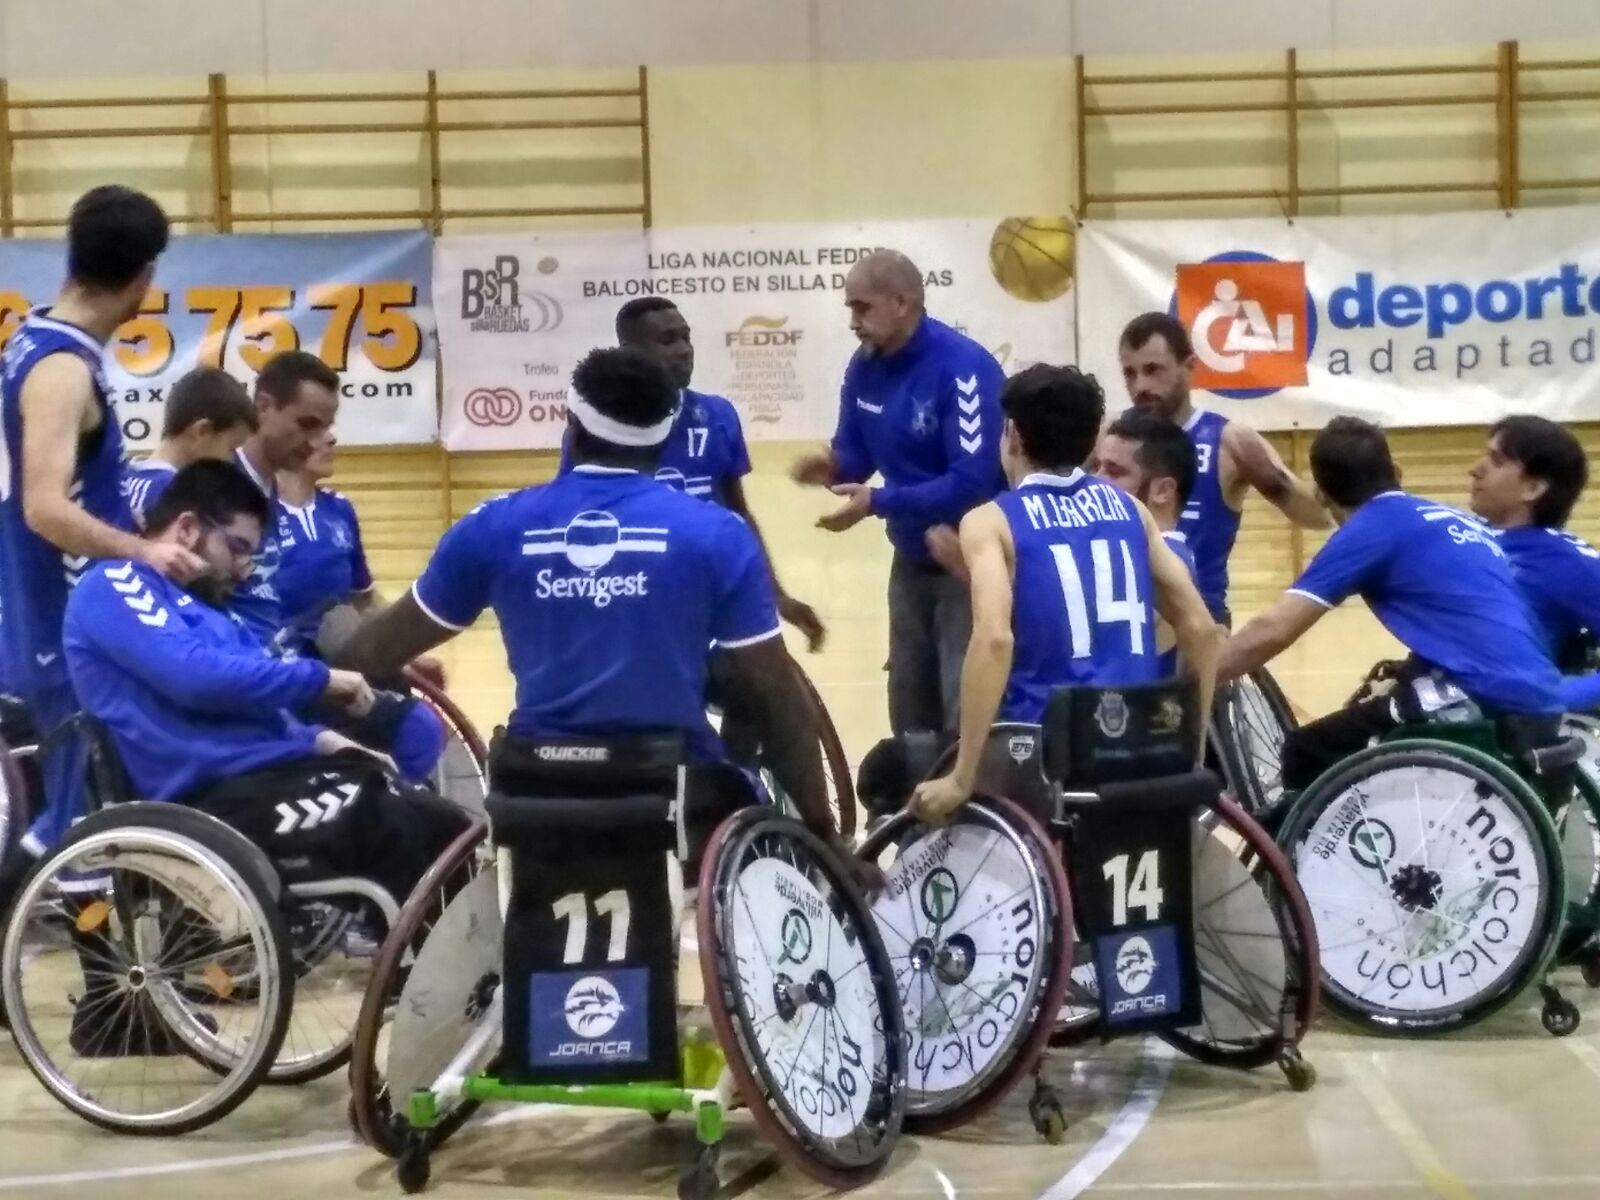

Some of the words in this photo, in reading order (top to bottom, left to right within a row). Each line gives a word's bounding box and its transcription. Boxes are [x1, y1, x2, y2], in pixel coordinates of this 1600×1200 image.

[648, 253, 696, 269] LIGA
[702, 250, 810, 268] NACIONAL
[818, 248, 886, 265] FEDD
[583, 277, 726, 297] BALONCESTO
[733, 276, 759, 292] EN
[767, 274, 826, 291] SILLA
[832, 274, 846, 290] D
[308, 282, 423, 372] 75
[726, 330, 803, 347] FEDDF
[523, 363, 559, 376] Trofeo
[529, 404, 569, 422] ON
[687, 427, 709, 457] 17
[535, 568, 648, 608] Servigest
[1048, 539, 1147, 659] 14
[1102, 849, 1163, 926] 14
[552, 889, 631, 964] 11
[549, 1041, 632, 1057] JOANCA
